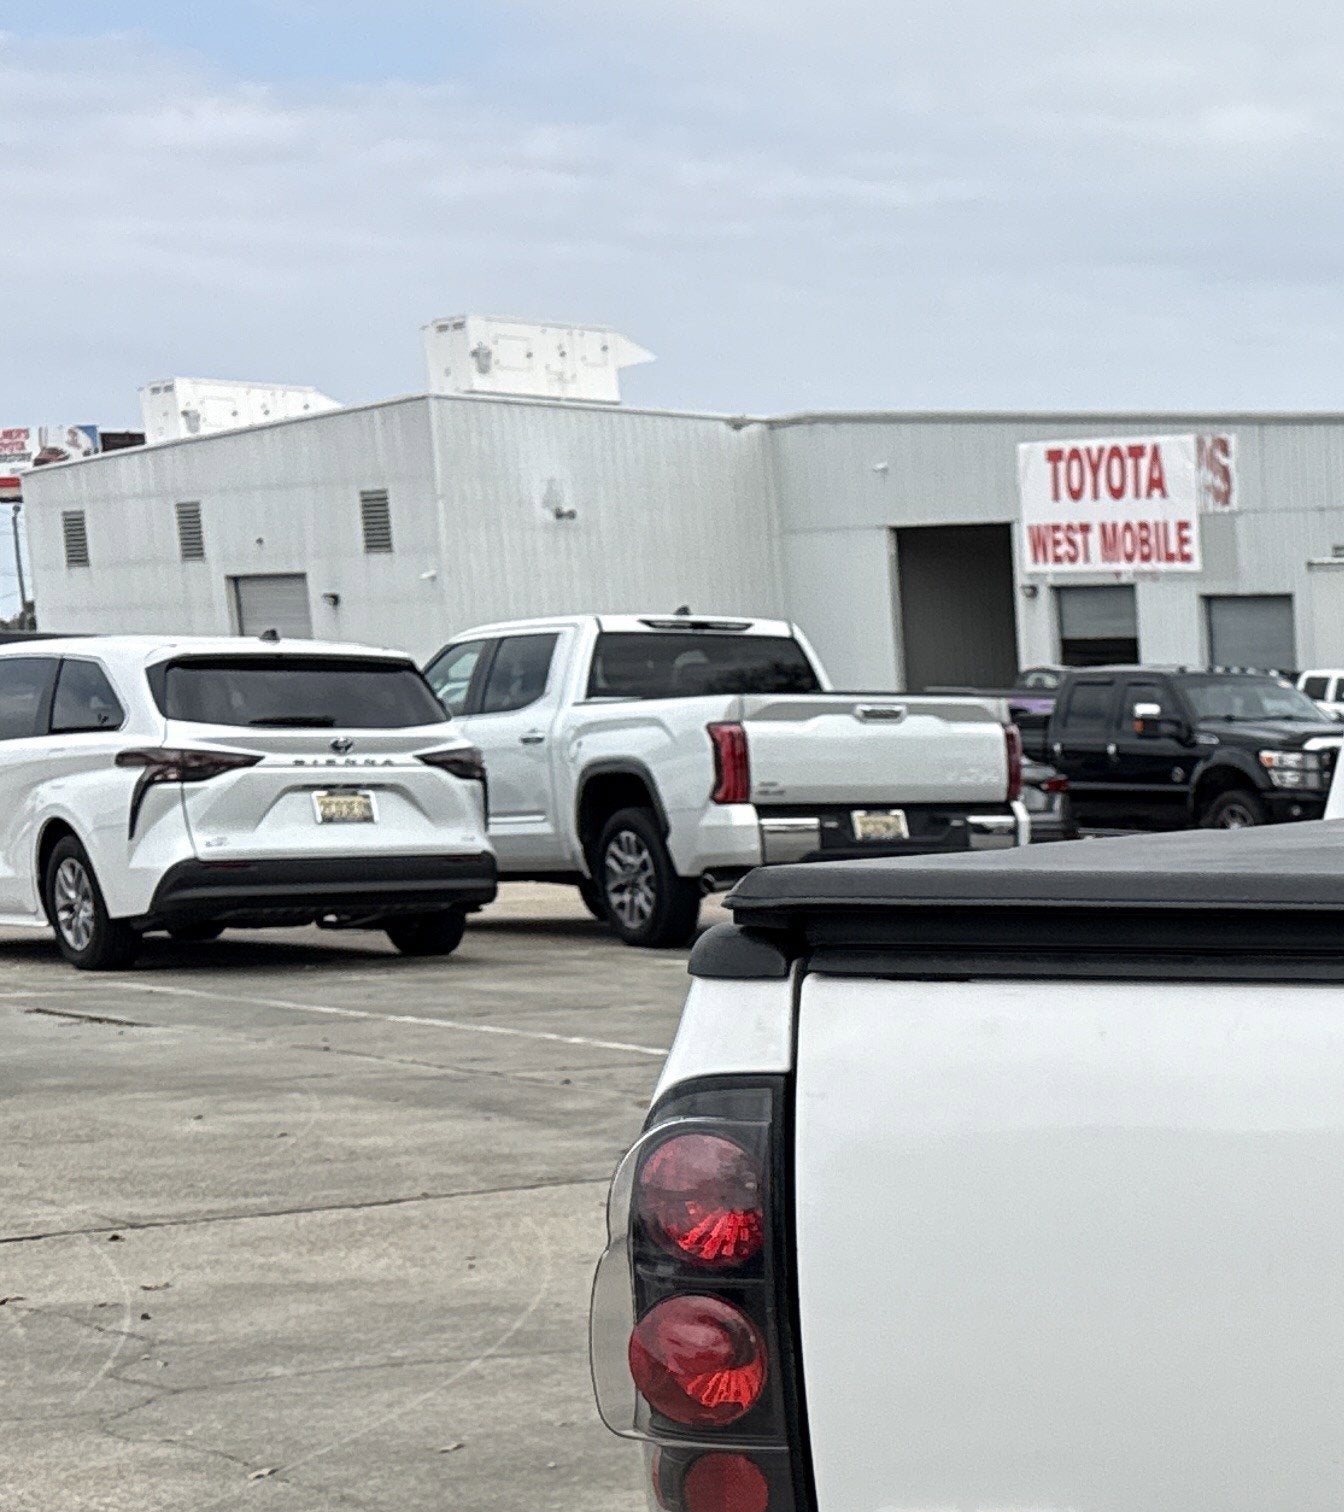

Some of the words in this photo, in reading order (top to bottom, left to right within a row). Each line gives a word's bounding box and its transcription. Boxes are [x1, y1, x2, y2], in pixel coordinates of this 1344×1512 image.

[1046, 443, 1168, 501] TOYOTA
[1028, 523, 1091, 565] WEST
[1100, 520, 1193, 564] MOBILE
